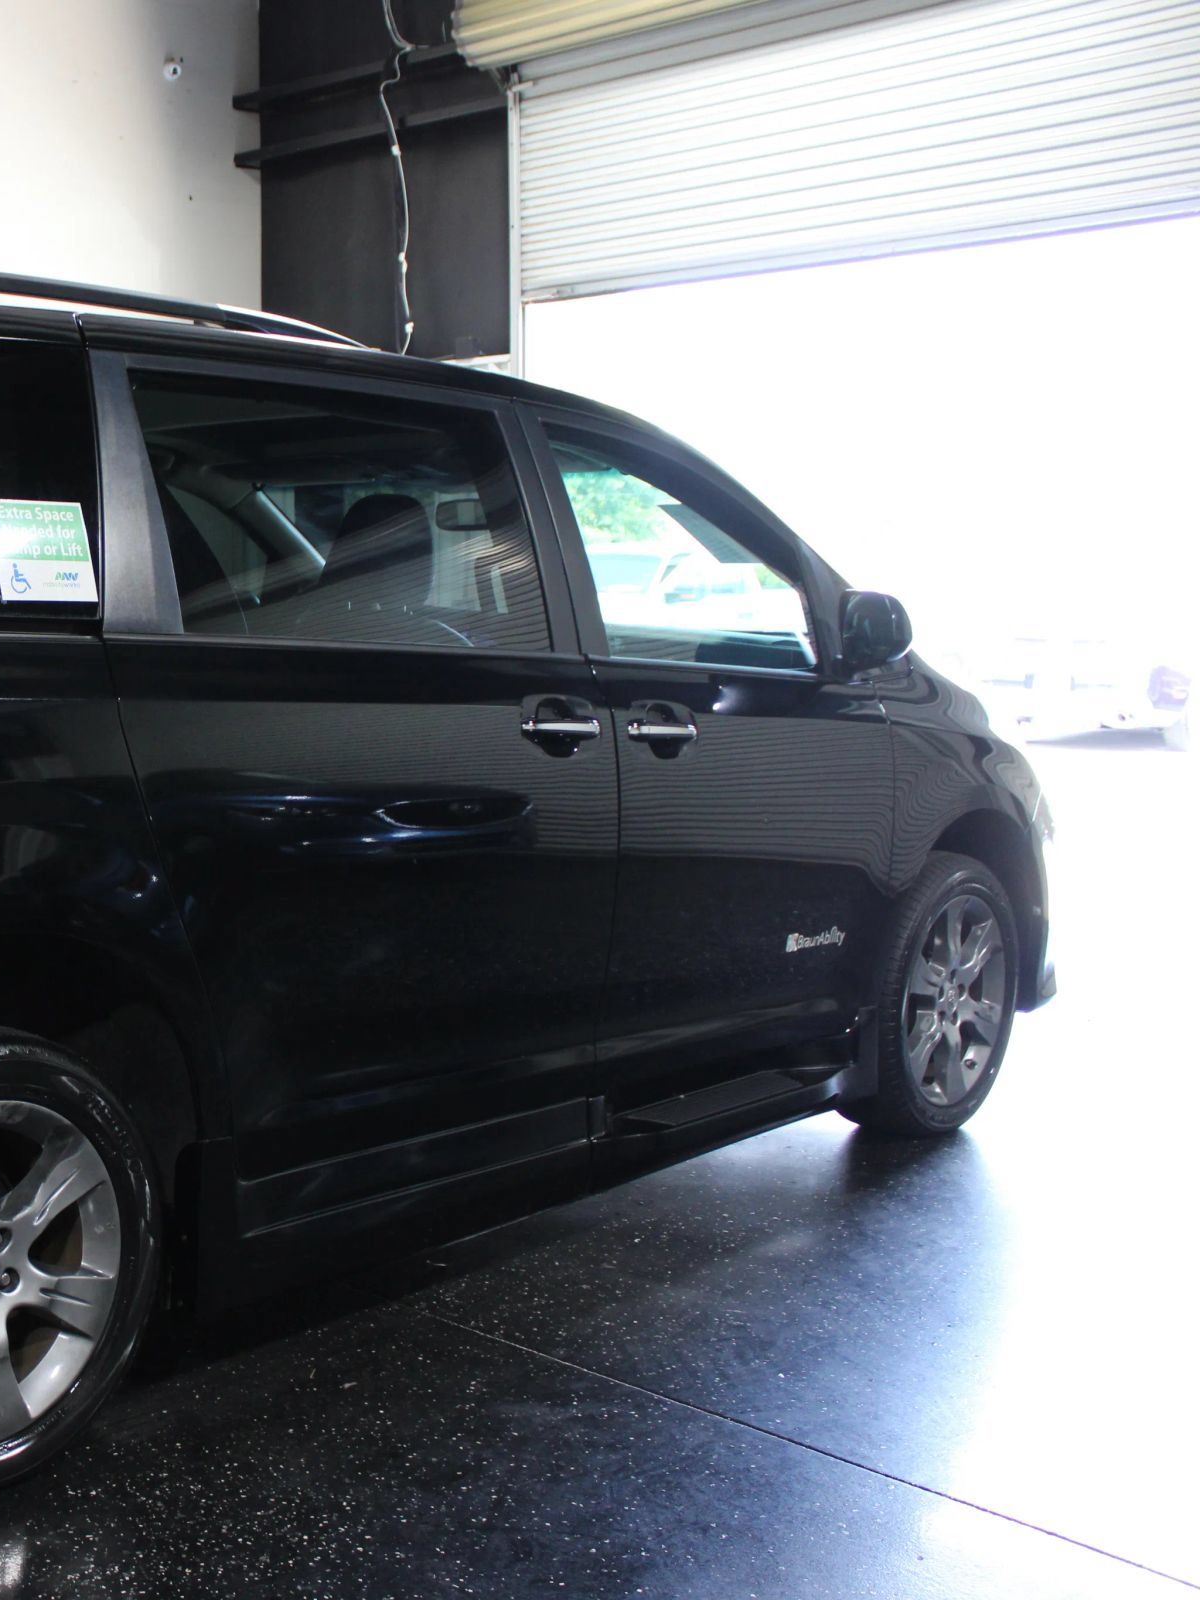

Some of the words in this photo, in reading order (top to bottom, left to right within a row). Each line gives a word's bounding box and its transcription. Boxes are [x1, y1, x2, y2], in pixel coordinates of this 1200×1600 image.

[35, 507, 74, 523] Space
[1, 523, 53, 538] eded
[56, 524, 76, 539] for
[43, 544, 58, 556] or
[60, 542, 83, 557] Lift
[797, 925, 846, 949] BraunAbility
